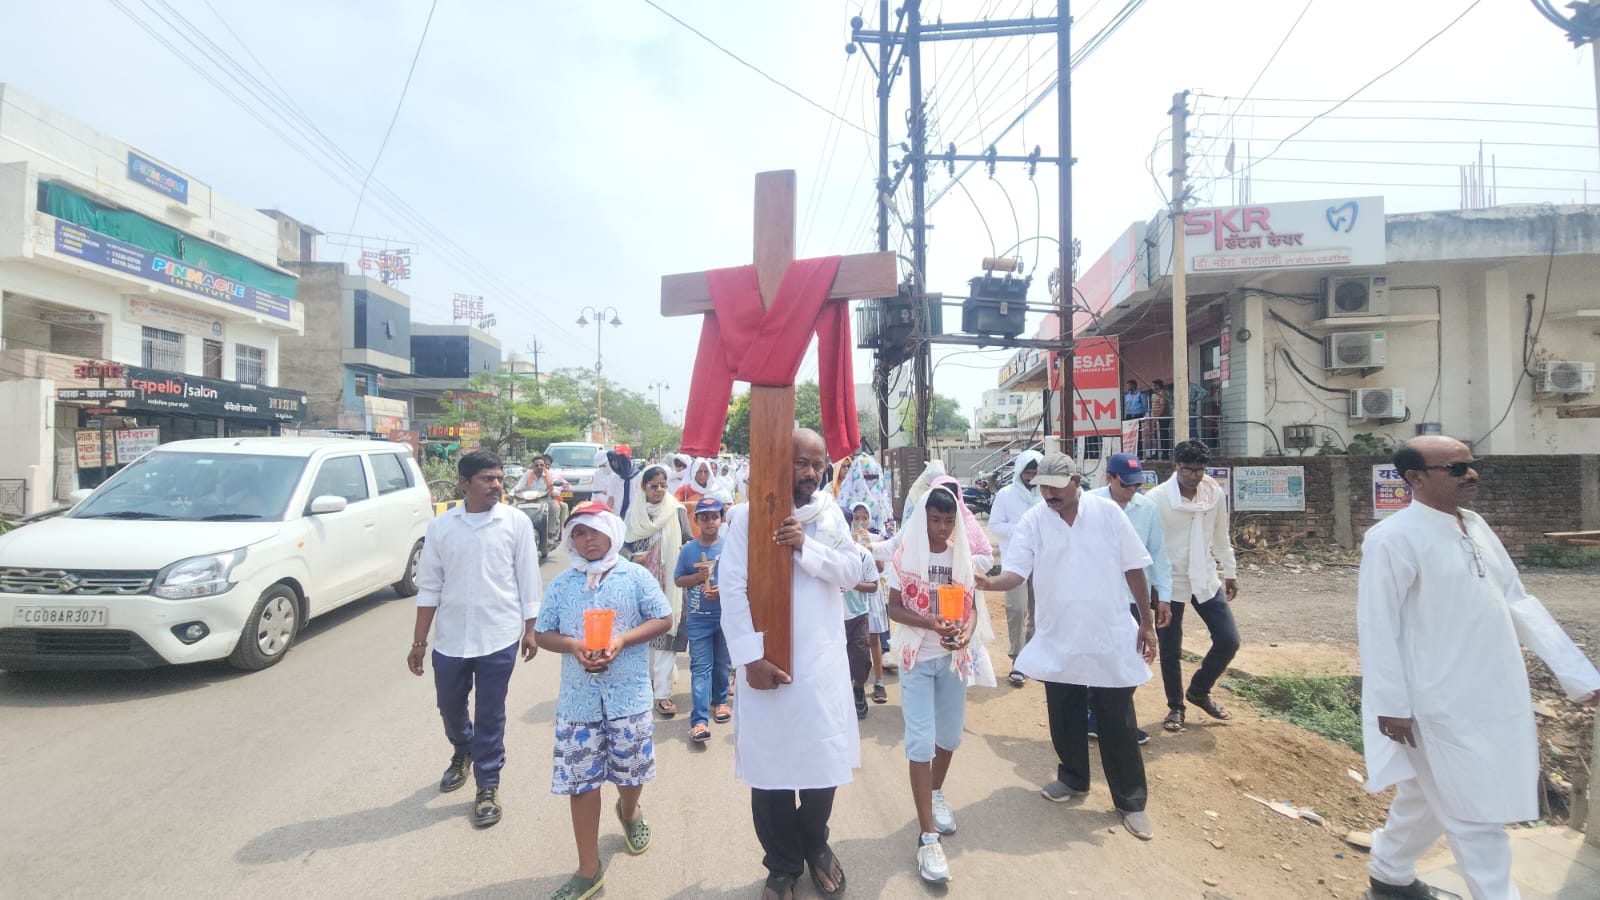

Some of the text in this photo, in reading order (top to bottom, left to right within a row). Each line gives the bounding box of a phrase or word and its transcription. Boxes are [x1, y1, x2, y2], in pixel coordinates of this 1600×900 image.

[1185, 207, 1271, 251] SKR
[1266, 232, 1304, 248] केयर
[152, 257, 246, 298] PINNACLE
[170, 277, 233, 301] INSTITUTE
[453, 298, 484, 310] CAKE
[1073, 353, 1115, 369] ESAF
[131, 378, 218, 400] capello salon
[25, 610, 103, 622] CG08AR3071
